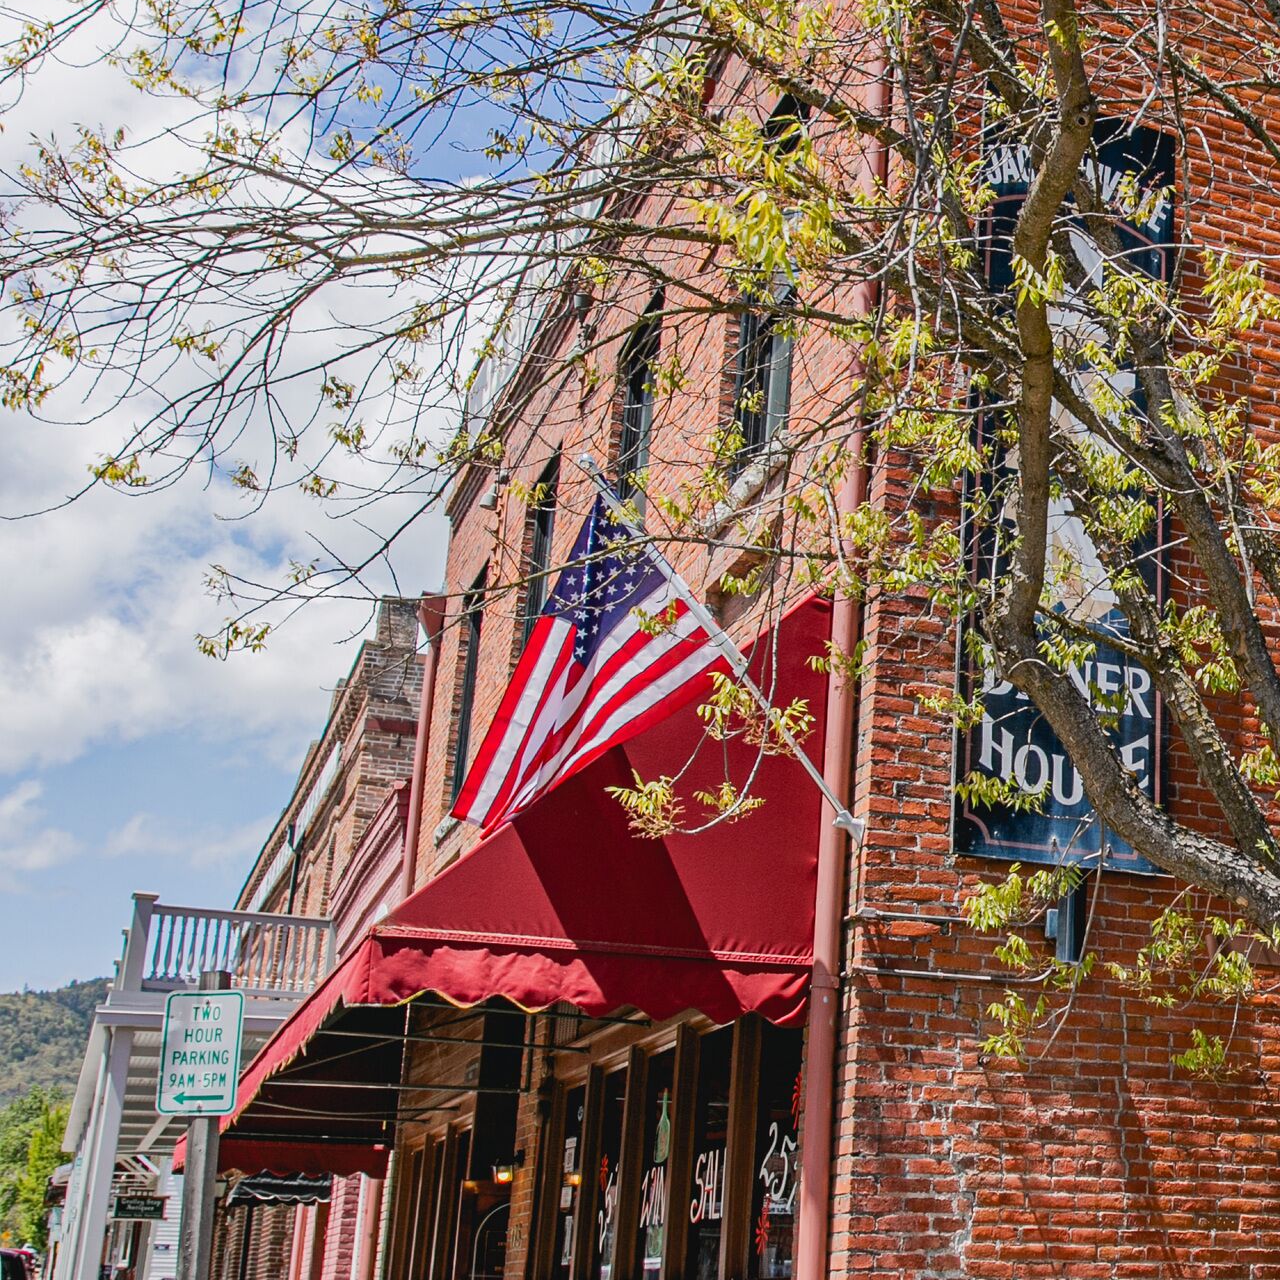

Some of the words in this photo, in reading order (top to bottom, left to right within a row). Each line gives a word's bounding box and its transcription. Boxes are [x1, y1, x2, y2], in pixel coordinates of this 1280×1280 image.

[982, 642, 1152, 718] DNER
[979, 711, 1150, 806] HOUE
[193, 1006, 222, 1021] TWO
[184, 1028, 223, 1043] HOUR
[172, 1050, 229, 1065] PARKING
